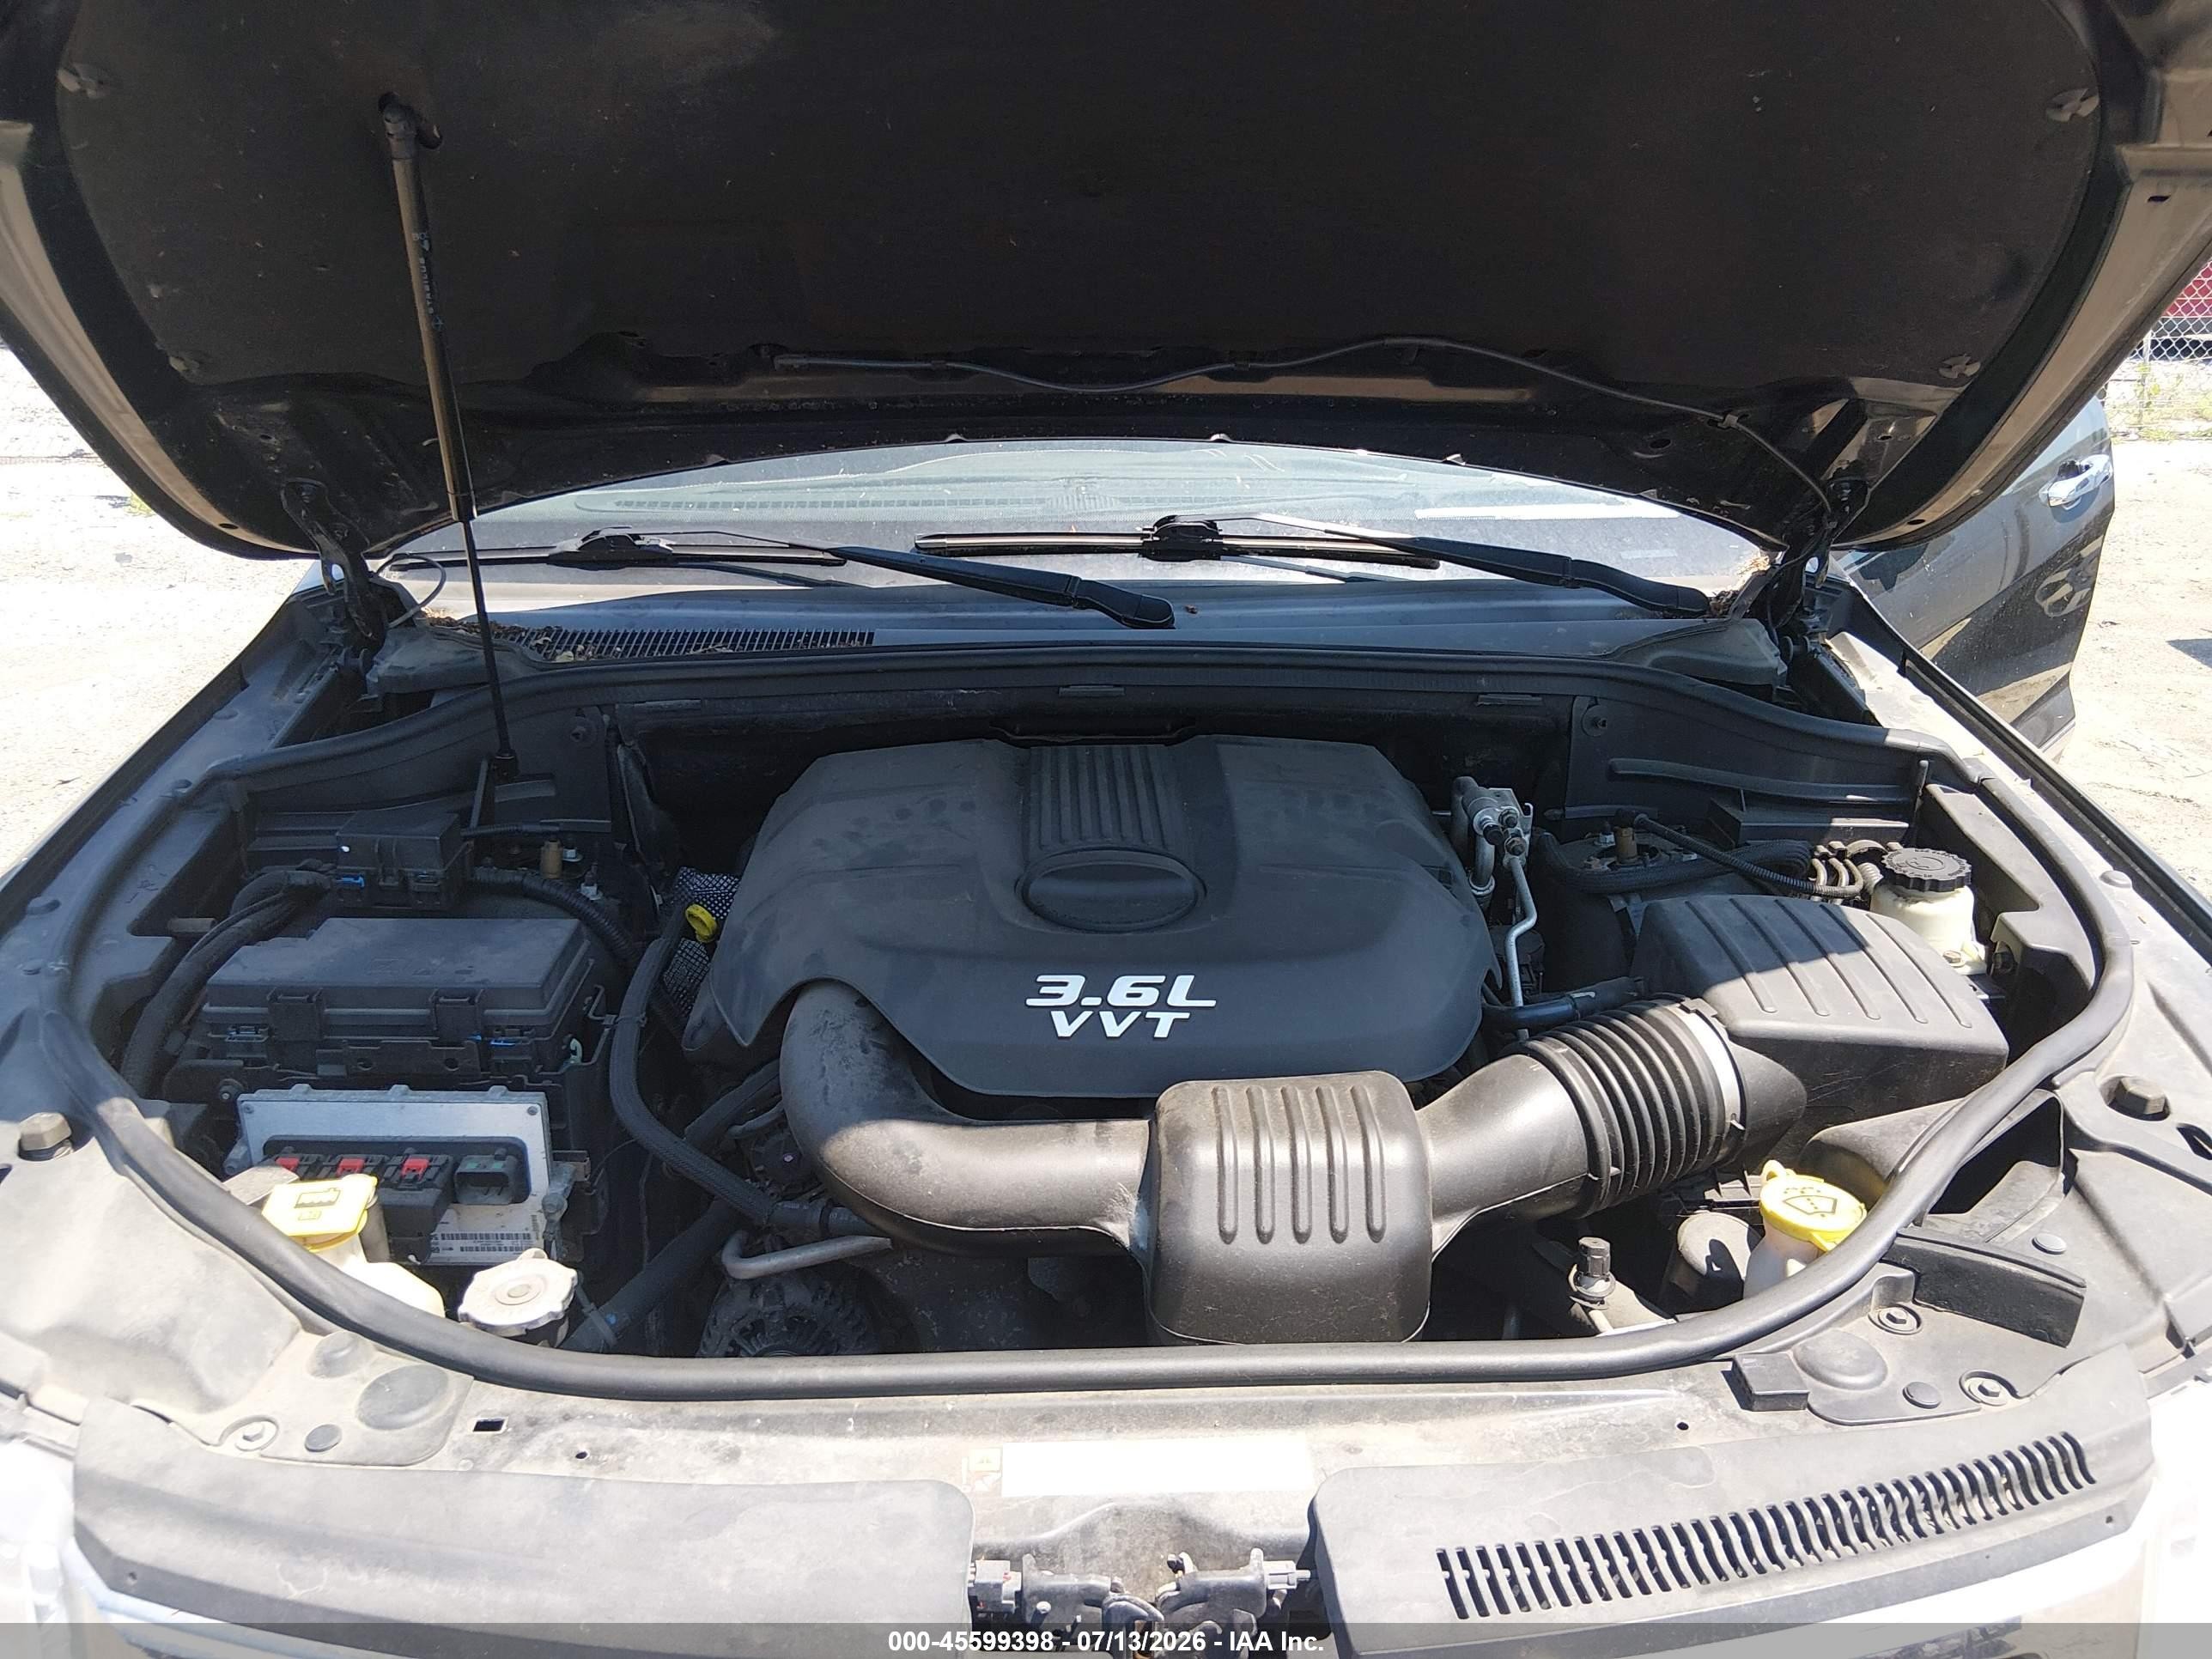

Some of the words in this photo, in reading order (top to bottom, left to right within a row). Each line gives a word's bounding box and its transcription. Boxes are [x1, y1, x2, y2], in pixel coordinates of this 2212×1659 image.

[419, 257, 434, 314] STABILUS
[1025, 974, 1217, 1007] 3.6L
[1049, 1010, 1191, 1038] VVT
